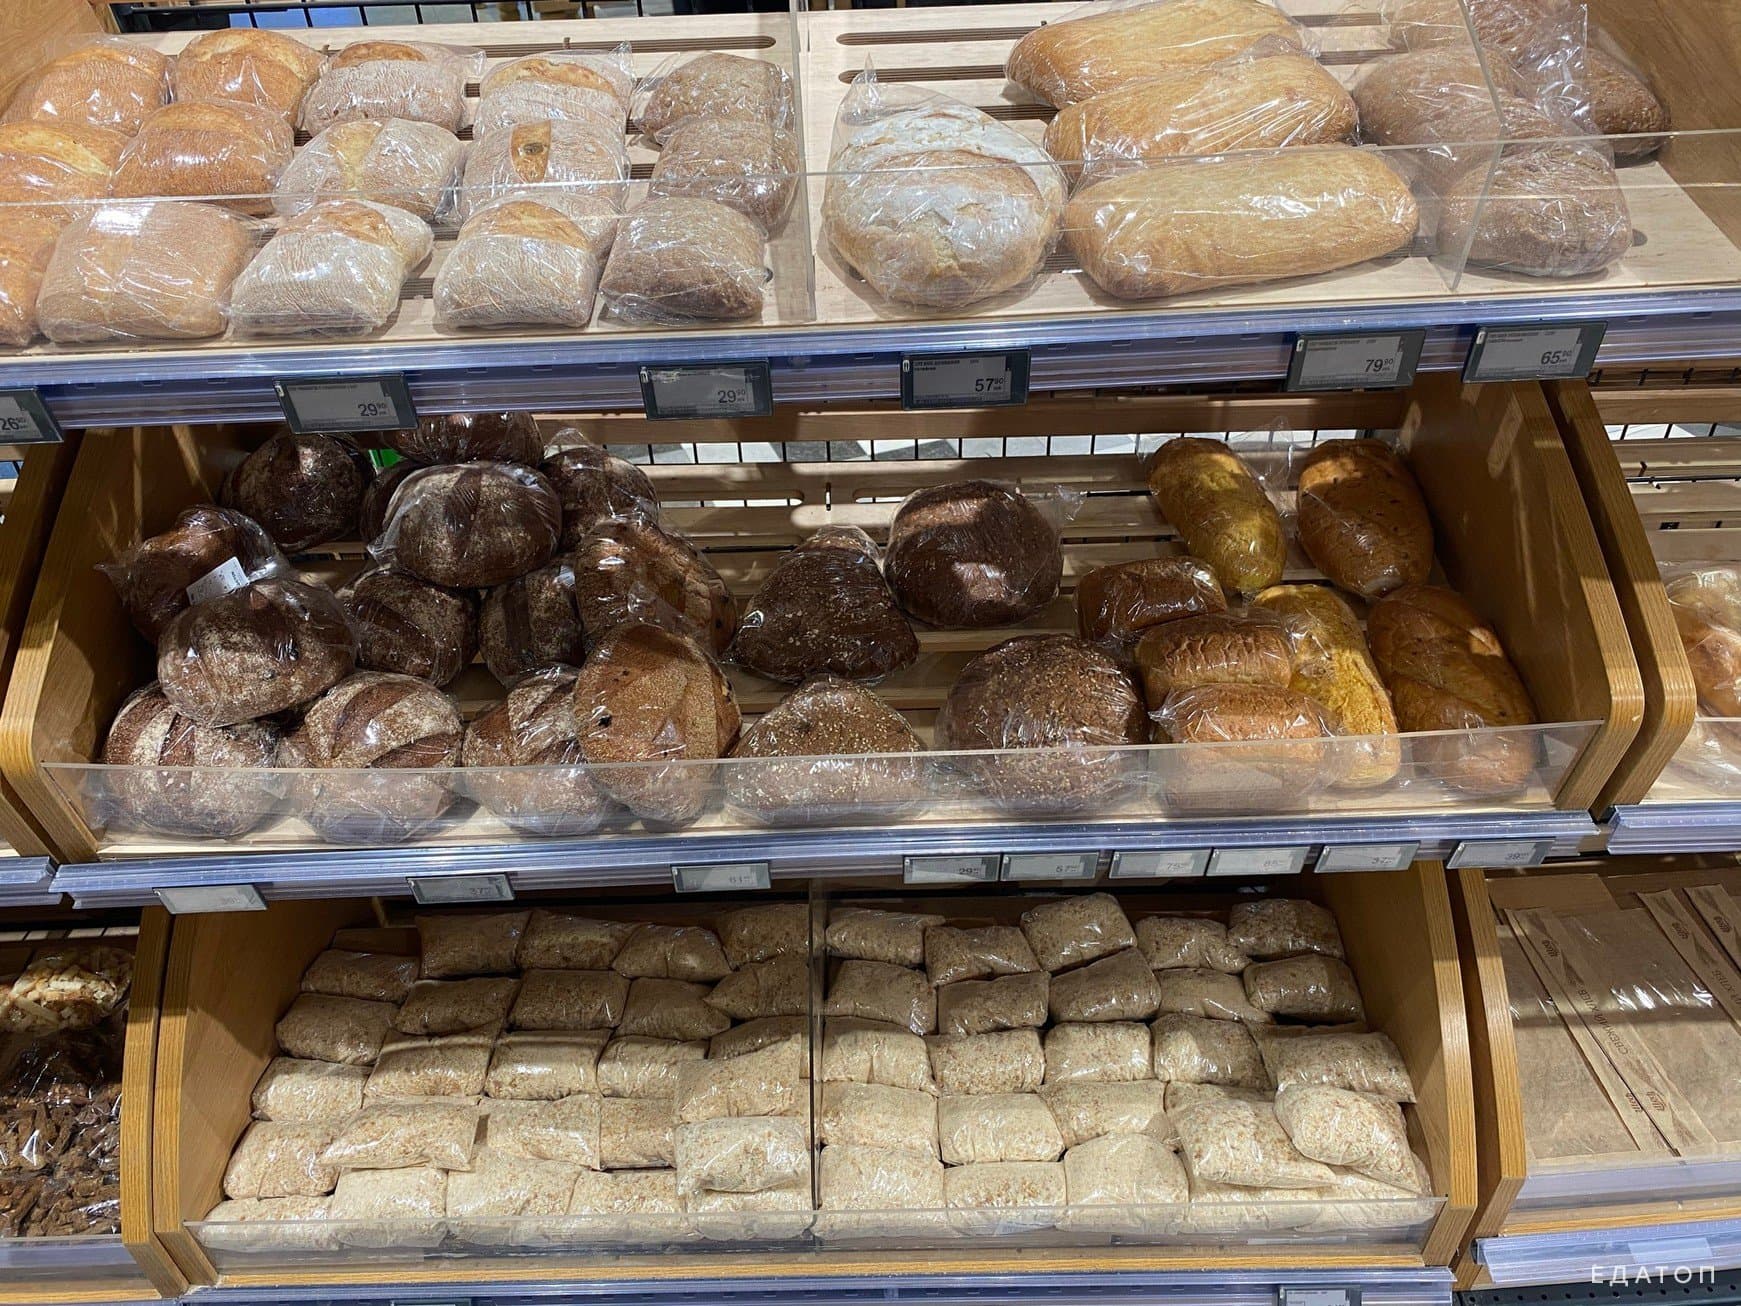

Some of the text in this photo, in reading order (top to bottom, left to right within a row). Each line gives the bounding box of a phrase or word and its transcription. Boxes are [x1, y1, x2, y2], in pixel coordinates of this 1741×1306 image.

[1541, 351, 1561, 365] 65
[1365, 359, 1384, 373] 79
[975, 378, 994, 392] 57
[717, 390, 736, 403] 29
[358, 403, 378, 417] 29
[0, 417, 19, 430] 26
[1578, 989, 1629, 1055] СВЕЖИЙ ХЛЕБ
